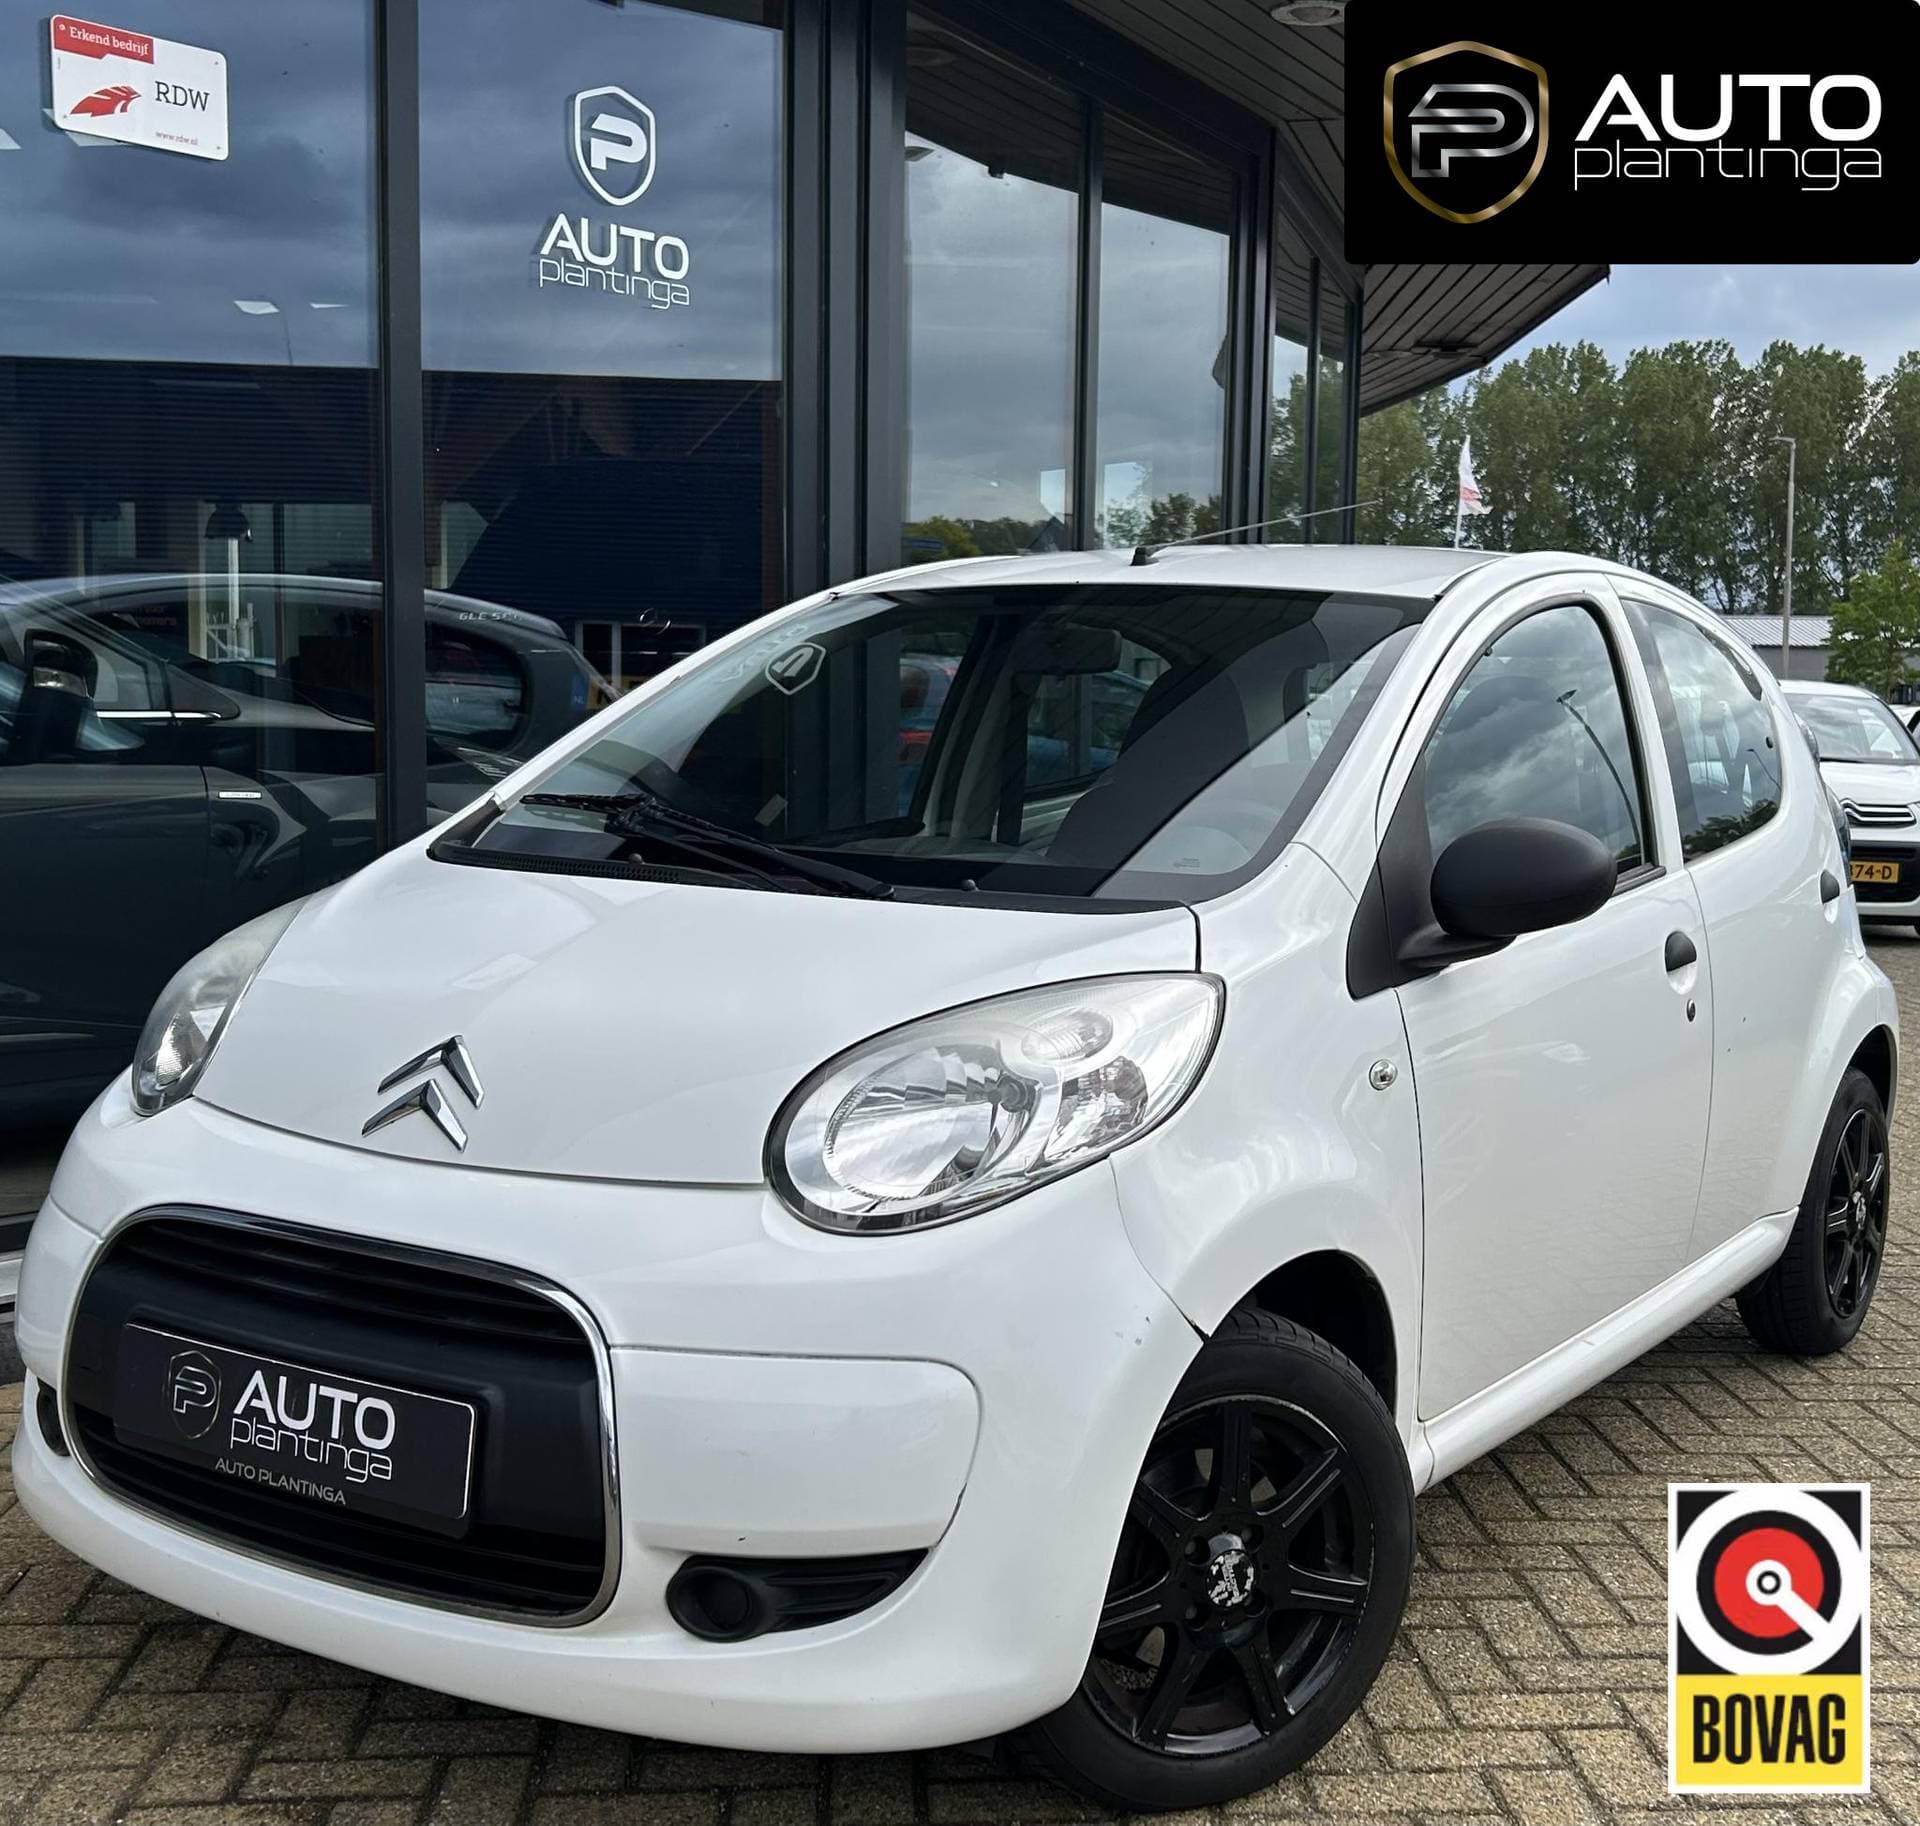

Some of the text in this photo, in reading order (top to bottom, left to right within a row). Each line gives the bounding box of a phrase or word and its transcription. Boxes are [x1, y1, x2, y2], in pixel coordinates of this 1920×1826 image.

[69, 26, 149, 57] Erkend bedrijf
[155, 80, 210, 112] RDW
[540, 213, 690, 280] AUTO
[540, 257, 690, 310] plantinga
[233, 1369, 396, 1450] AUTO
[230, 1417, 392, 1483] plantinga
[215, 1457, 346, 1505] AUTO PLANTINGA
